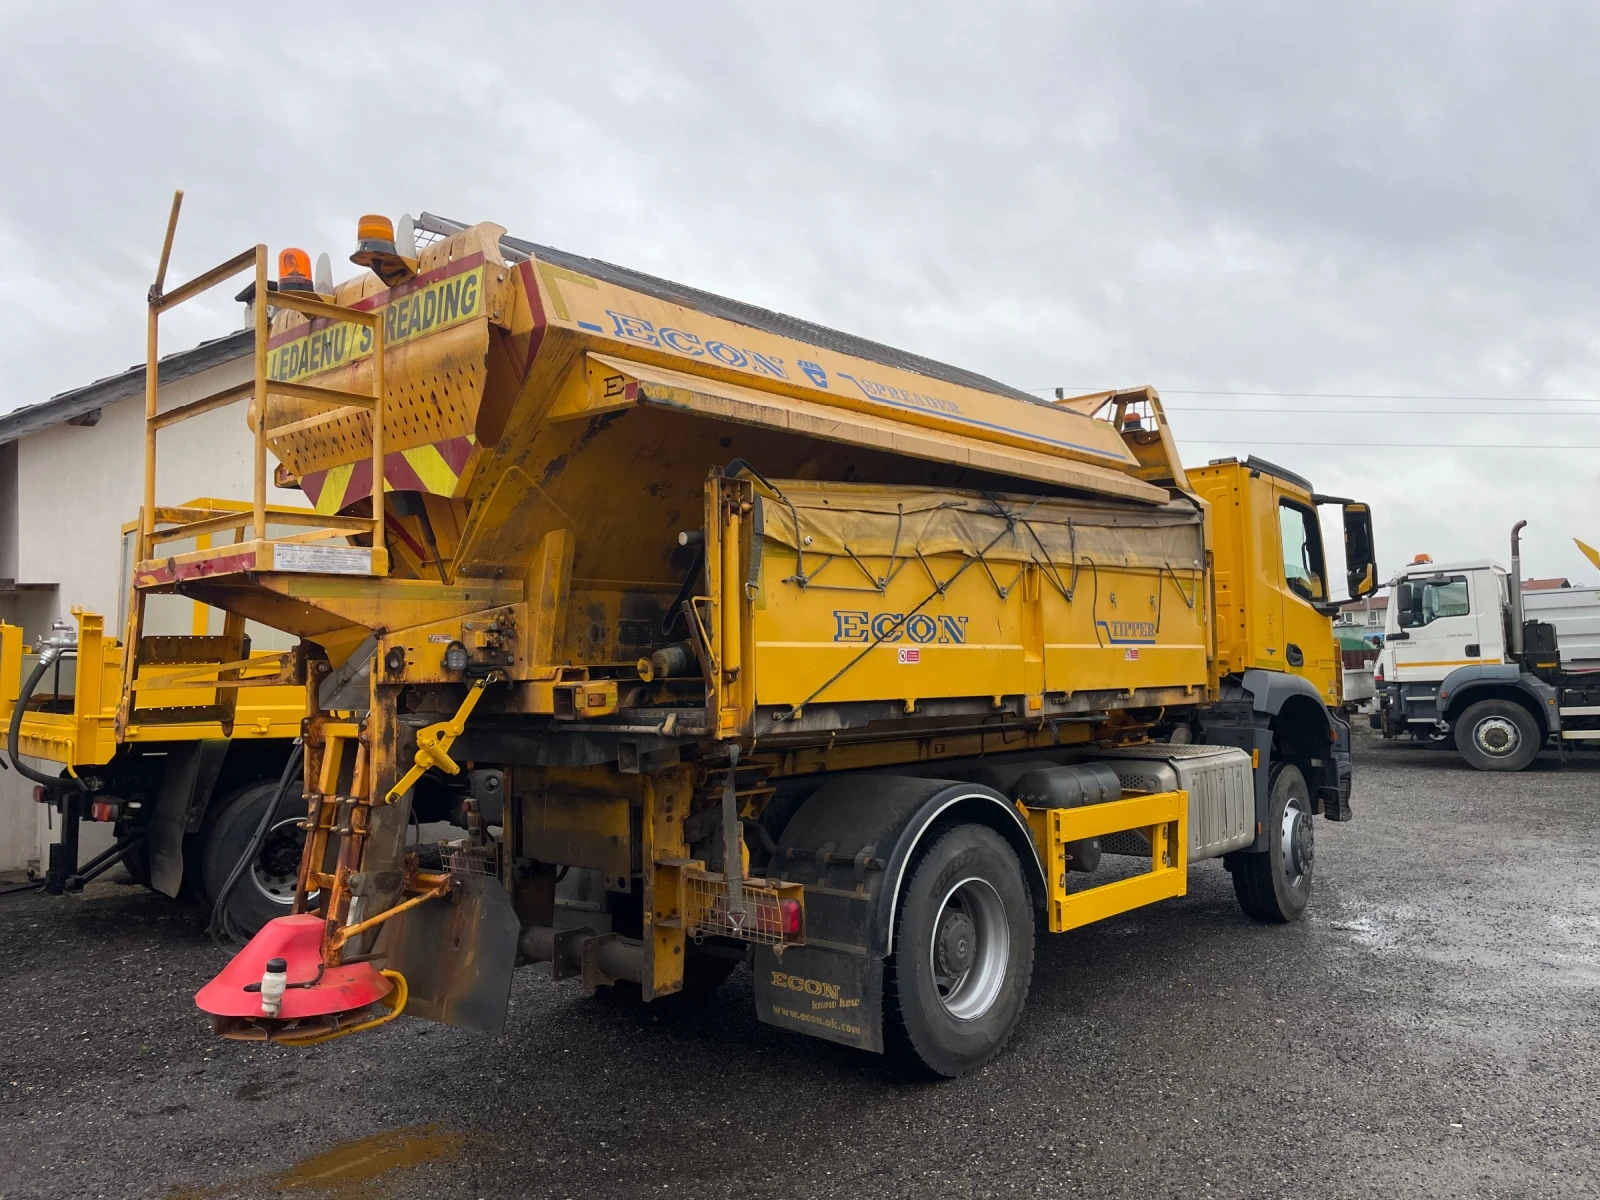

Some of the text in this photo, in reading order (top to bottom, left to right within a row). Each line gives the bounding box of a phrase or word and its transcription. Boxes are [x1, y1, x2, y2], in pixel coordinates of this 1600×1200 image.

[267, 324, 347, 382] LEDAENU
[360, 274, 478, 352] SREADING
[605, 309, 790, 380] ECON
[861, 378, 963, 415] SPREADER
[833, 611, 969, 644] ECON
[1111, 621, 1156, 637] TIPPER
[771, 971, 840, 1000] ECON
[812, 998, 860, 1010] know how
[772, 1006, 861, 1035] www.econ.uk.com
